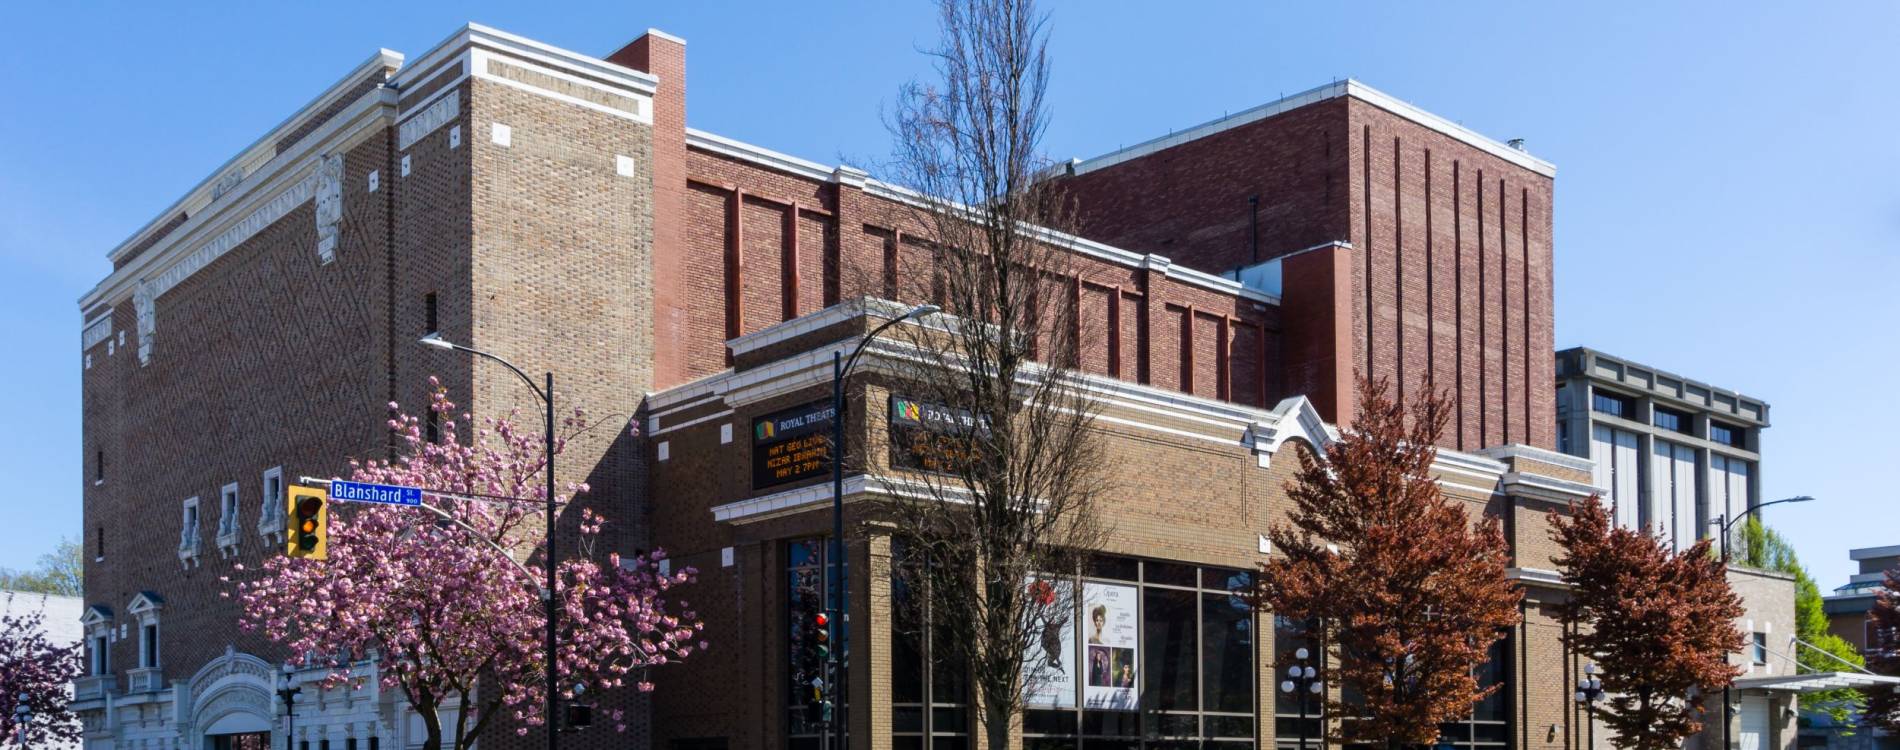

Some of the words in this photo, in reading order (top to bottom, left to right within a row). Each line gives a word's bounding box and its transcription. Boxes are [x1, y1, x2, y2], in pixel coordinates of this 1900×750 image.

[780, 416, 804, 431] ROYAL
[805, 407, 836, 424] THEATR
[786, 440, 801, 452] GEO
[776, 466, 791, 478] MAY
[803, 460, 820, 472] 7PM
[334, 483, 401, 503] Blanshard
